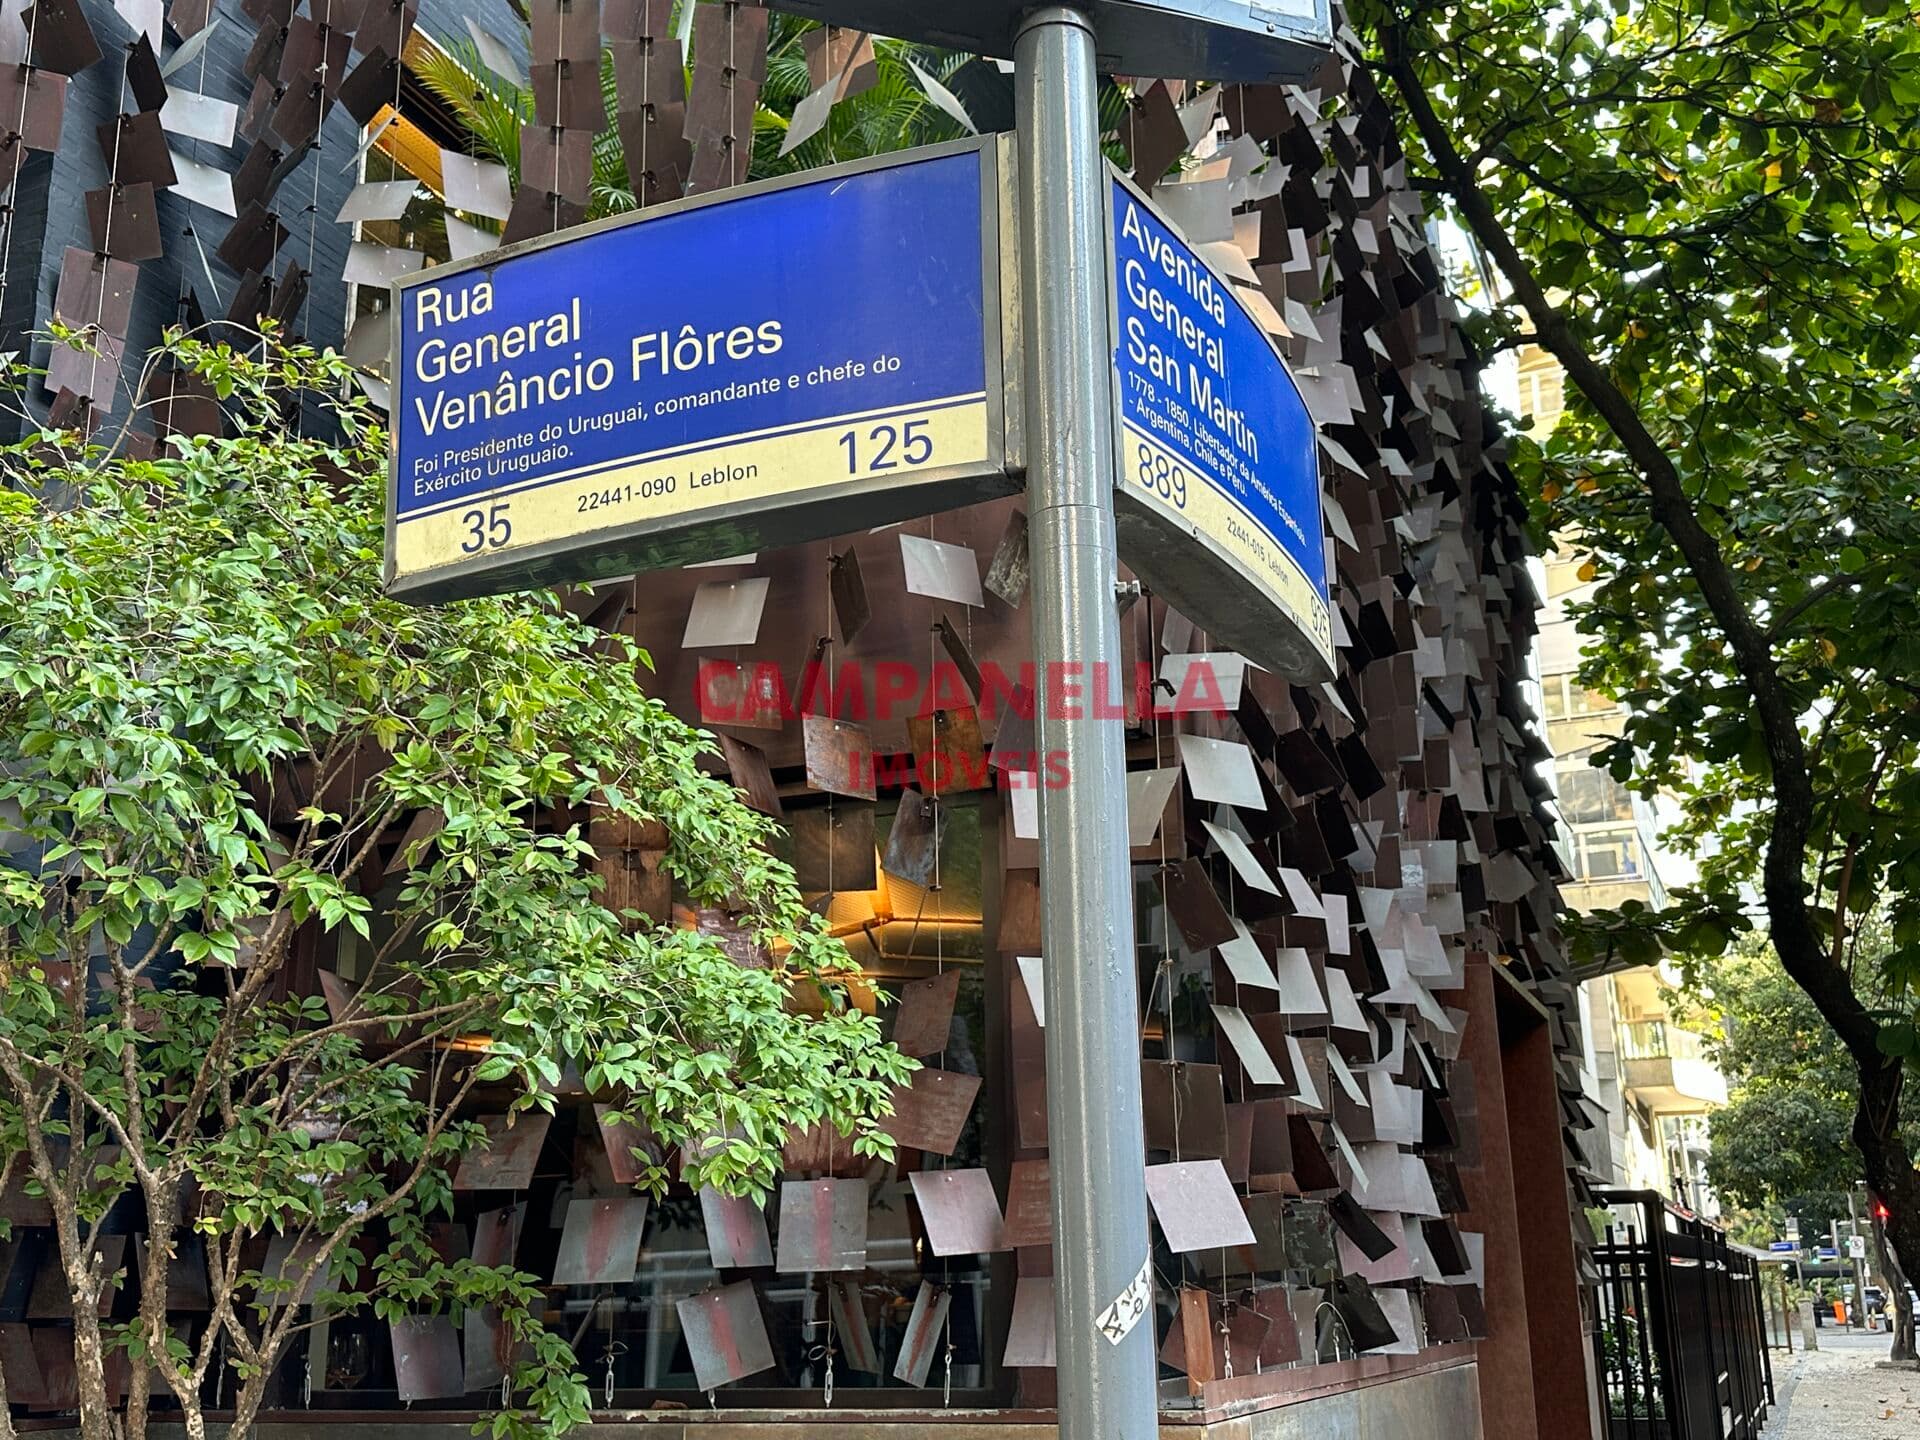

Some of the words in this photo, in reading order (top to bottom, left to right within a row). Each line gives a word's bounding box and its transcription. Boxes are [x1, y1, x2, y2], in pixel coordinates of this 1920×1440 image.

[416, 282, 493, 333] Rua
[1122, 202, 1225, 328] Avenida
[1125, 259, 1225, 379] General
[415, 297, 580, 383] General
[415, 352, 615, 436] Venâncio
[632, 320, 783, 381] Flôres
[1127, 316, 1181, 394] San
[1189, 363, 1258, 465] Martin
[414, 454, 438, 477] Foi
[444, 431, 534, 471] Presidente
[540, 424, 563, 442] do
[568, 402, 648, 435] Uruguai,
[655, 377, 781, 415] comandante
[788, 373, 800, 389] e
[807, 360, 865, 385] chefe
[873, 355, 901, 375] do
[414, 465, 482, 497] Exército
[487, 443, 573, 477] Uruguaio.
[1128, 371, 1155, 402] 1778
[1164, 397, 1192, 430] 1850.
[1193, 418, 1238, 467] Libertador
[1240, 461, 1250, 481] da
[1136, 398, 1193, 452] Argentina,
[1195, 439, 1218, 470] Chile
[1220, 464, 1226, 476] e
[1227, 467, 1248, 497] Peru.
[462, 504, 512, 553] 35
[578, 476, 676, 512] 22441-090
[690, 463, 758, 489] Leblon
[839, 419, 933, 474] 125
[1138, 443, 1187, 509] 889
[1268, 551, 1289, 587] Leblon
